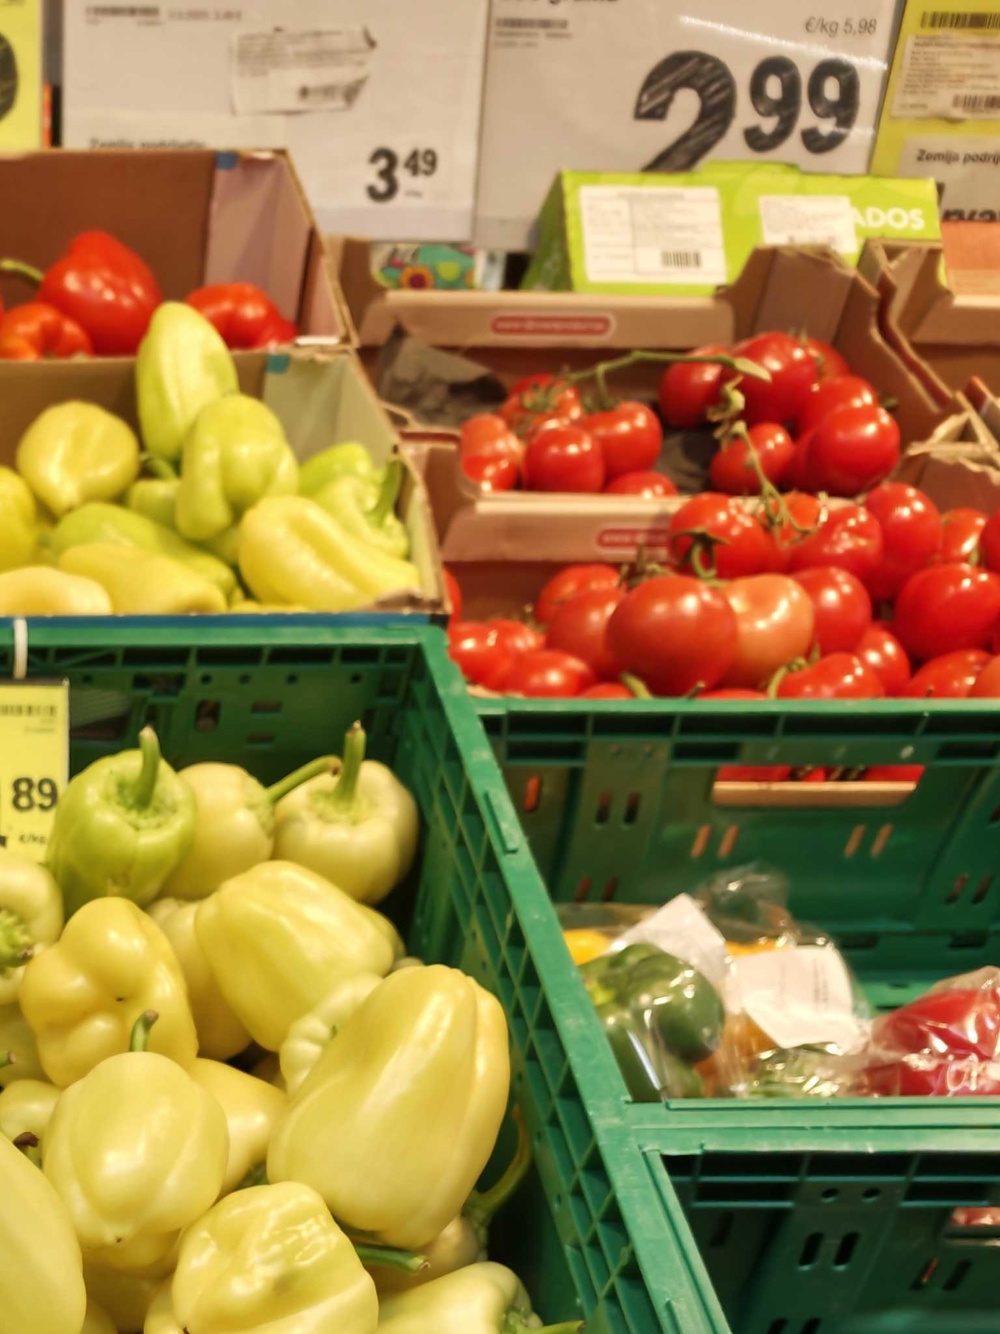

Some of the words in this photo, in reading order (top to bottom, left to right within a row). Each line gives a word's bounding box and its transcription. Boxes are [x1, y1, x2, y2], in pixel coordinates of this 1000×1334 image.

[634, 51, 737, 171] 2
[744, 55, 860, 153] 99
[366, 147, 399, 203] 3
[403, 148, 437, 177] 49
[12, 777, 58, 812] 89
